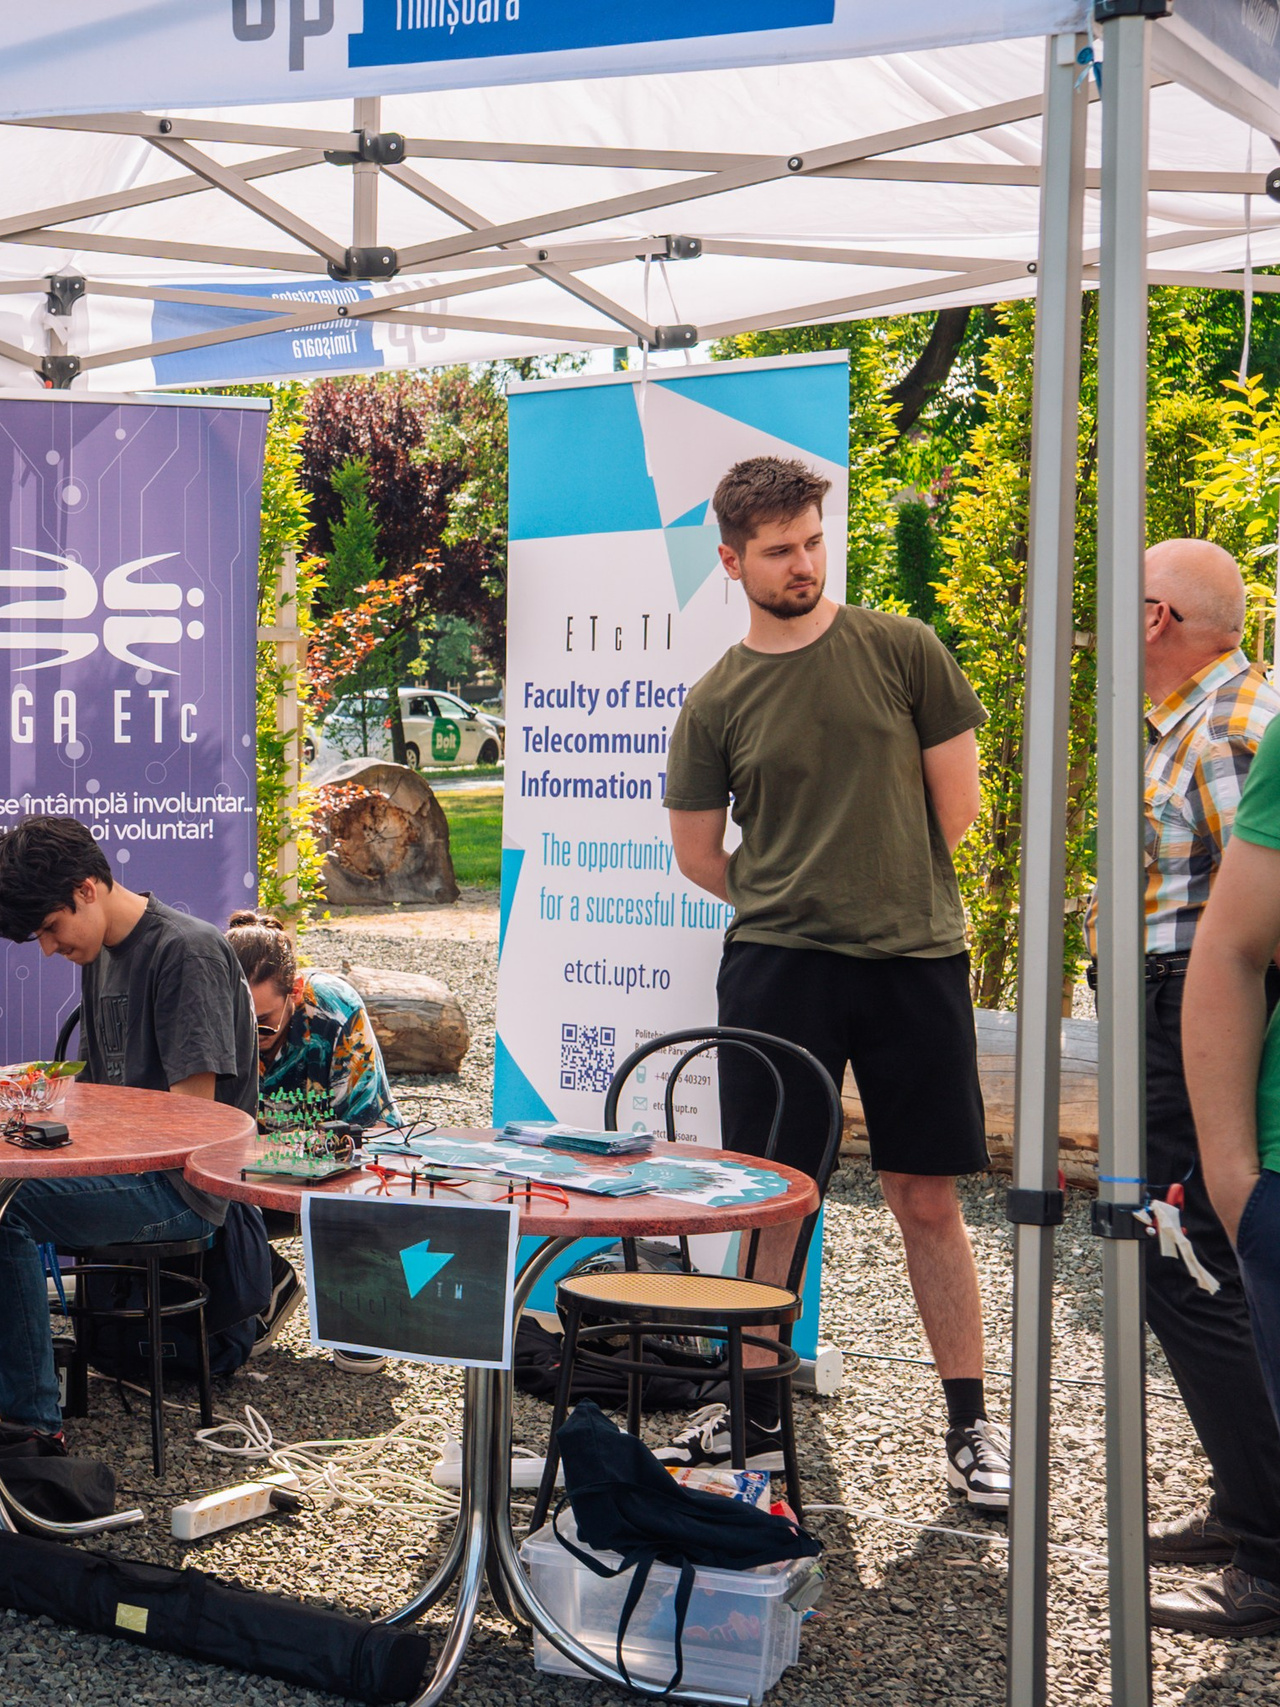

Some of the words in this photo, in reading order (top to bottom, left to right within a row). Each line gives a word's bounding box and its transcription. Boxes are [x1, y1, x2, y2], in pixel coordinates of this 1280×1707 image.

[524, 681, 600, 716] Faculty
[606, 680, 630, 708] of
[523, 725, 671, 754] Telecommuni
[521, 770, 652, 799] Information
[23, 792, 128, 819] întâmplă
[114, 818, 213, 841] voluntar!
[542, 832, 571, 867] The
[578, 836, 674, 875] opportunity
[540, 887, 564, 921] for
[570, 895, 579, 921] a
[586, 892, 674, 927] successful
[681, 893, 734, 930] future
[564, 959, 671, 994] etcti.upt.ro
